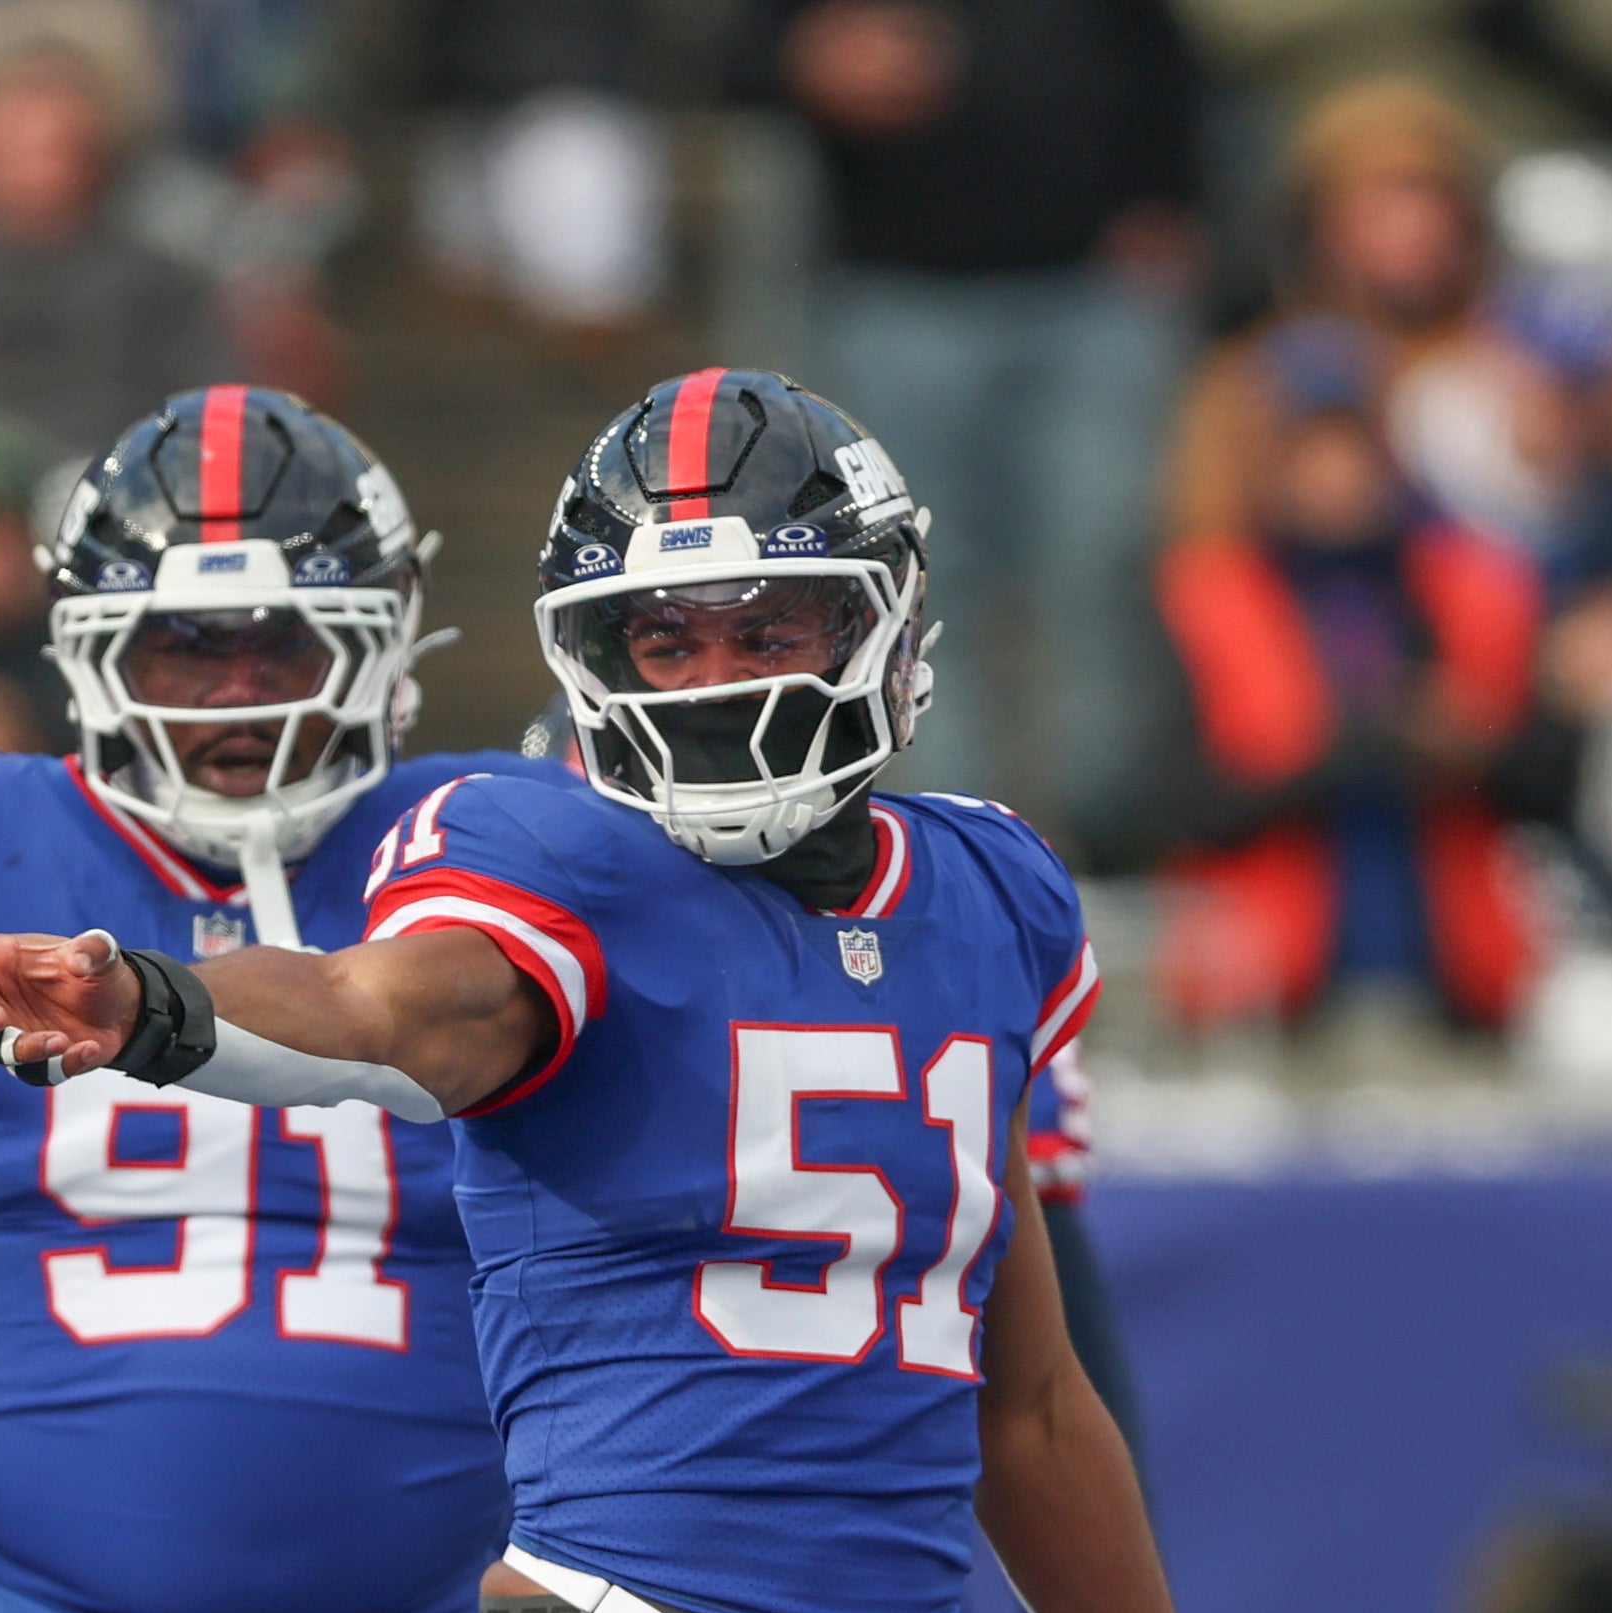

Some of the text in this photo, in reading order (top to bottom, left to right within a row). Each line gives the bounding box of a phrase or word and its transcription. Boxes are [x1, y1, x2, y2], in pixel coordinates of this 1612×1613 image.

[660, 526, 713, 547] GIANTS
[767, 541, 825, 553] OAKLEY
[574, 560, 617, 577] OAKLEY
[849, 951, 877, 974] NFL
[39, 1067, 410, 1353] 91
[692, 1019, 1002, 1383] 51
